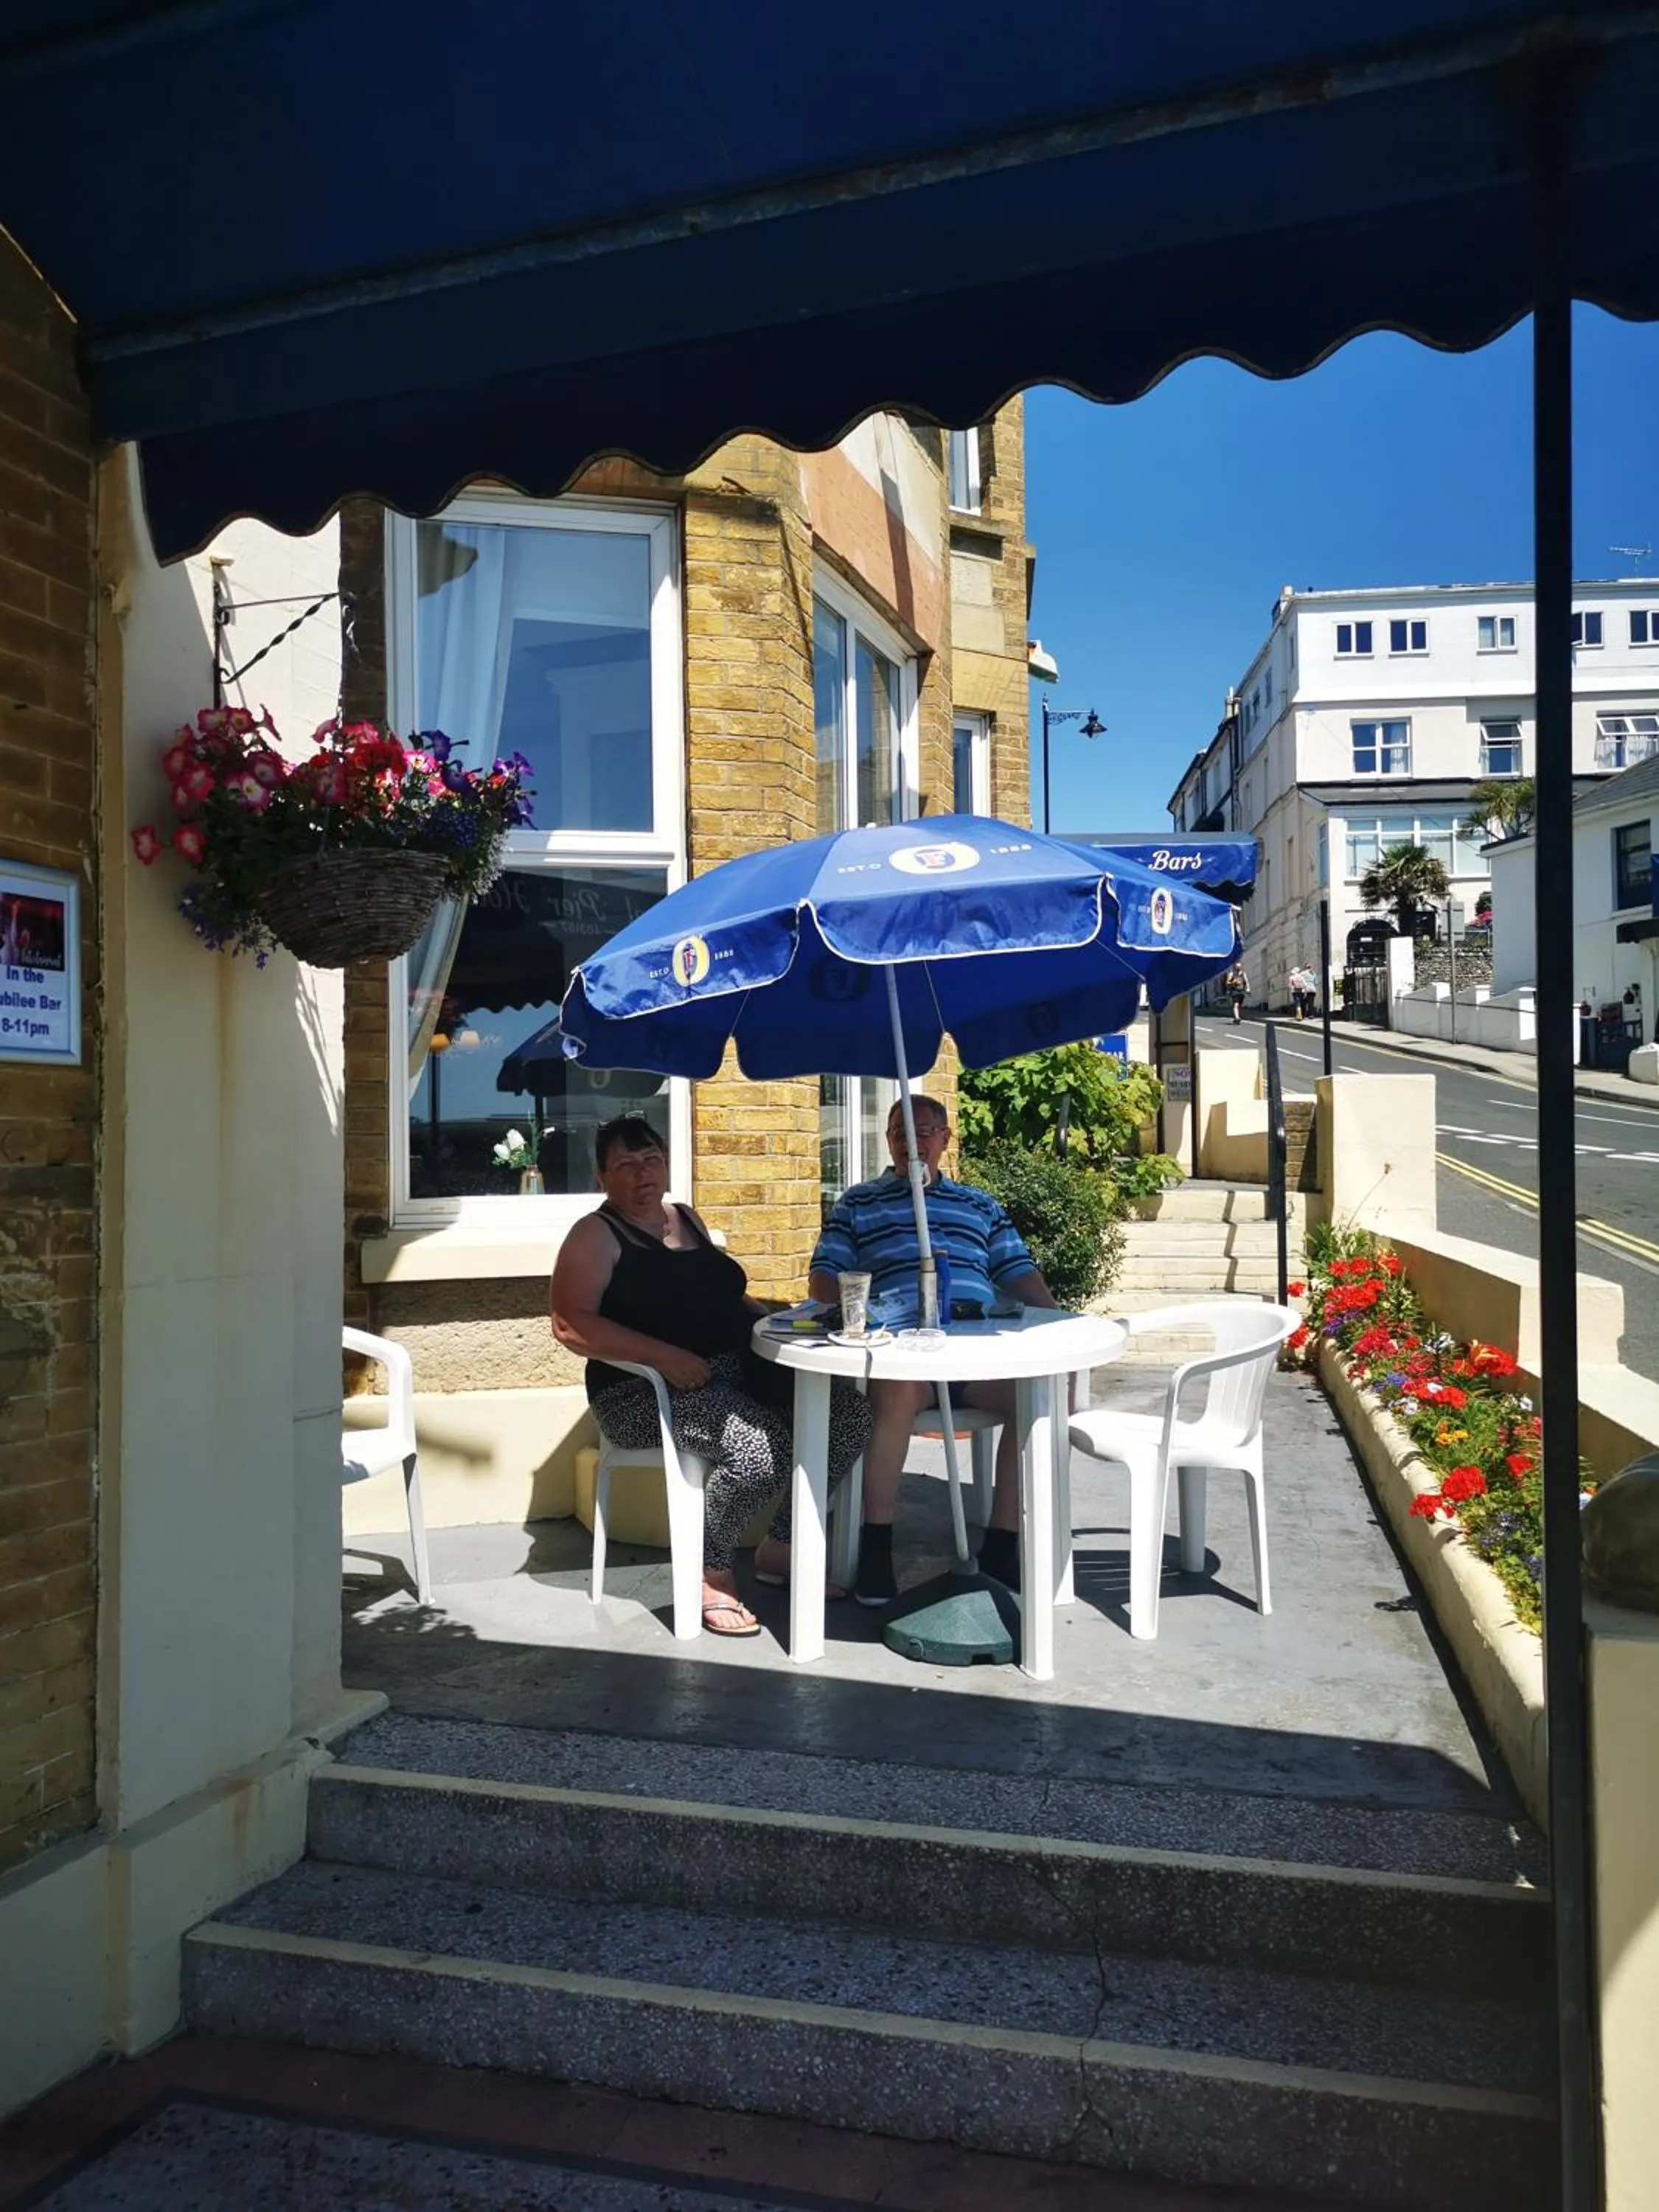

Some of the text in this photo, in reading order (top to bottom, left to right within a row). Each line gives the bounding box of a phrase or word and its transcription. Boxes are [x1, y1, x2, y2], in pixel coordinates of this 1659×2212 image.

[1148, 849, 1201, 871] Bars
[7, 965, 44, 984] In the
[40, 995, 61, 1011] Bar
[2, 1018, 49, 1038] 8-11pm
